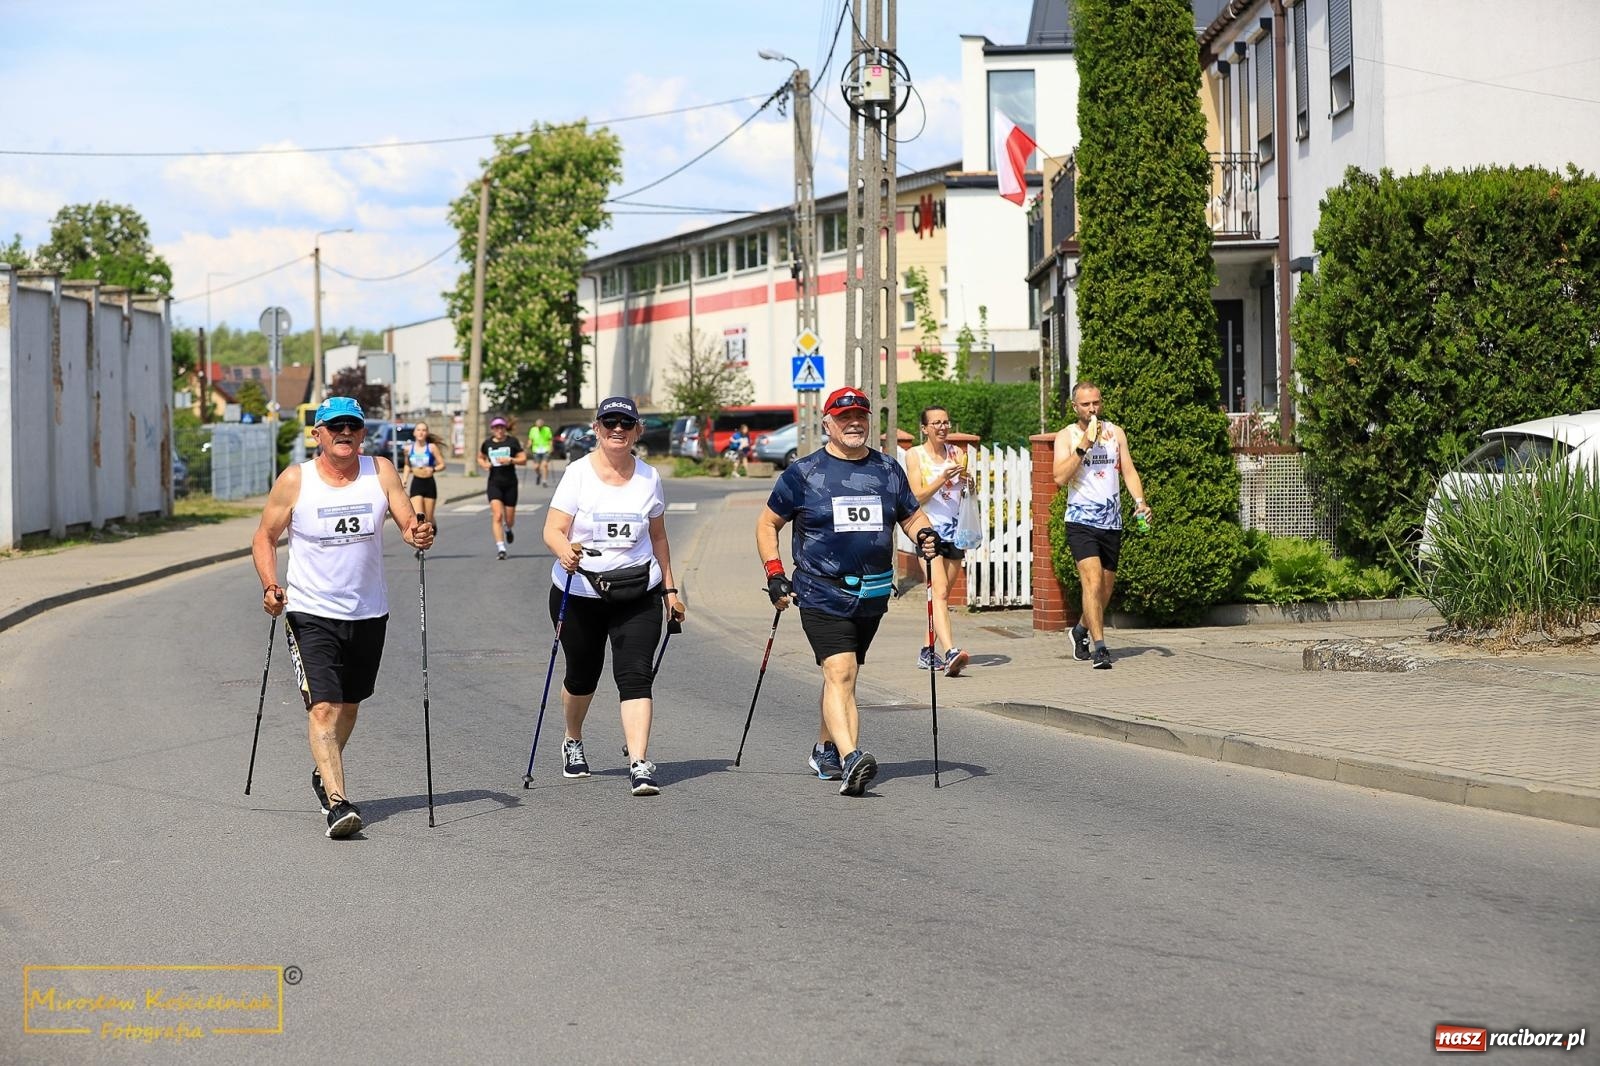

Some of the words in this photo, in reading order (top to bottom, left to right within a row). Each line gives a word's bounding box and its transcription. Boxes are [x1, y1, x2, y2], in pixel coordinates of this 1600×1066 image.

[603, 401, 632, 411] adidas
[847, 507, 871, 522] 50
[334, 516, 361, 534] 43
[607, 523, 632, 538] 54
